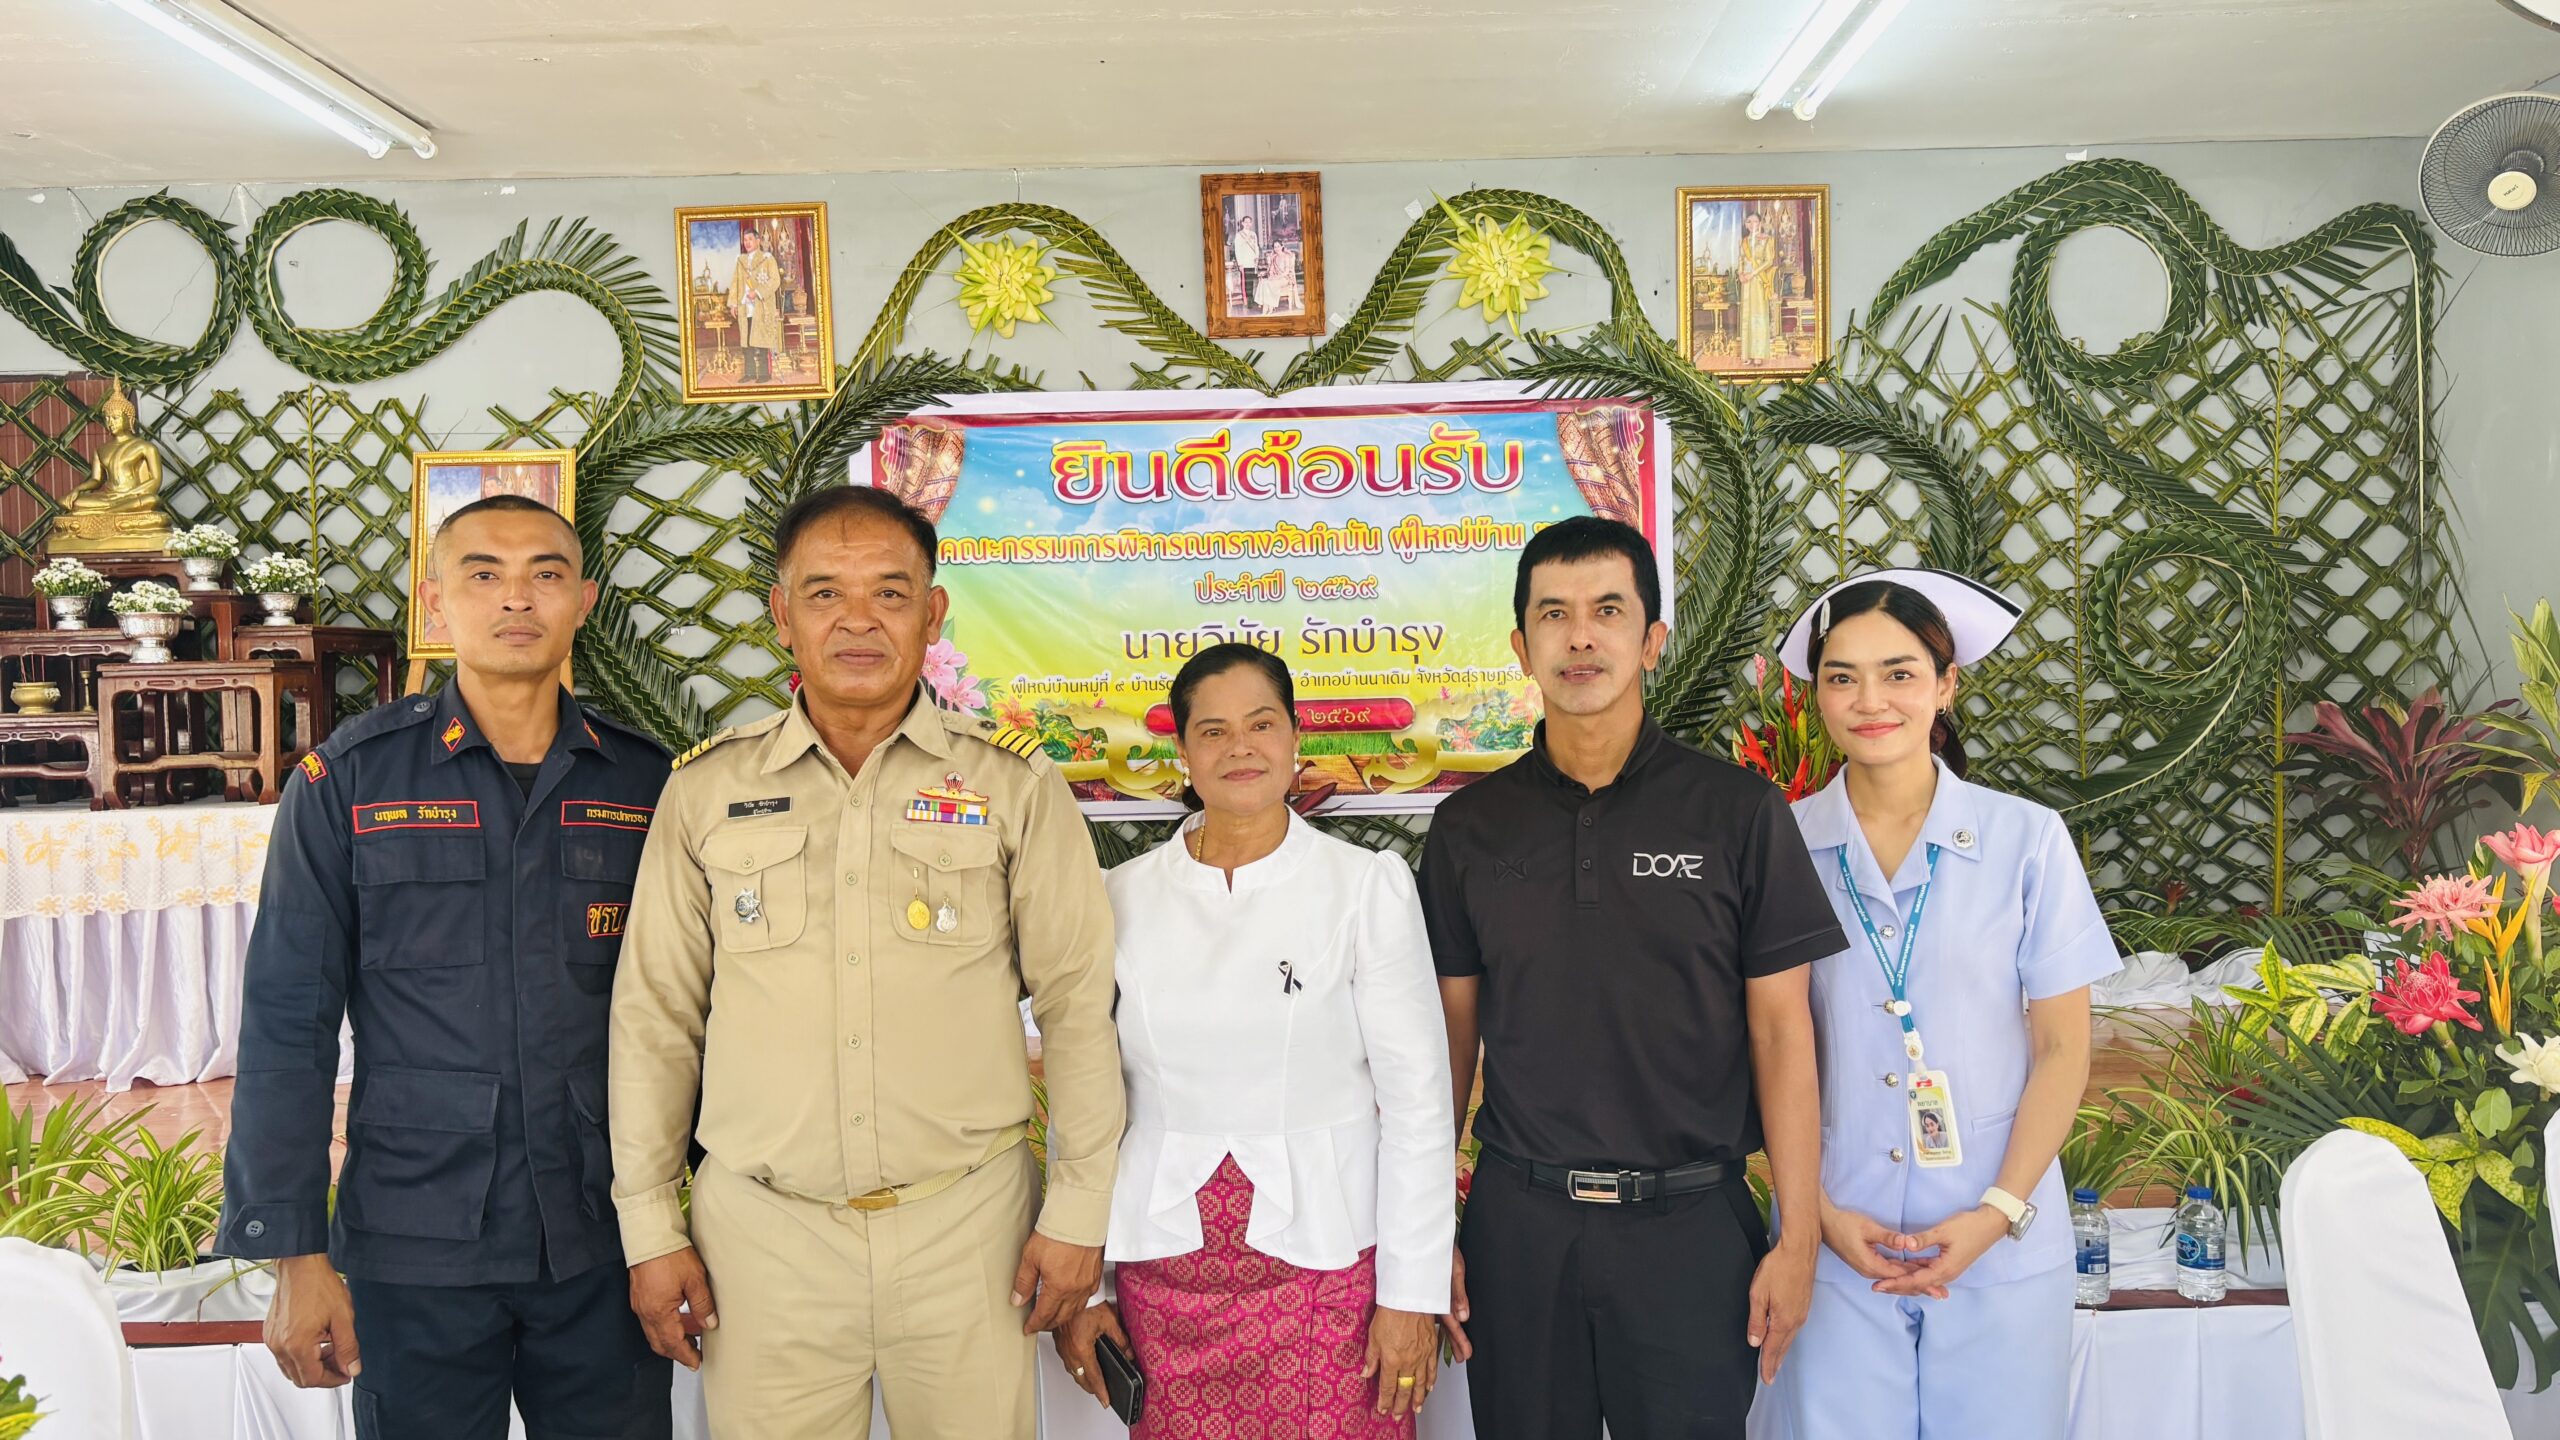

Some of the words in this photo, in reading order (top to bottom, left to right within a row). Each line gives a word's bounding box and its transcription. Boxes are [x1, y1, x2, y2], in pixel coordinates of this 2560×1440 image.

[1049, 421, 1525, 504] ยินดีต้อนรับ
[937, 518, 1382, 565] คณะกรรมการพิจารณารางวัลกำนัน
[1389, 514, 1526, 564] ผู้ใหญ่บ้าน
[1195, 568, 1286, 603] ประจำปี
[1292, 575, 1379, 600] ๒๕๖๙
[1300, 617, 1444, 664] รักบำรุง
[1011, 673, 1109, 698] ผู้ใหญ่บ้านหมู่ที่
[1307, 707, 1371, 724] ๒๕๖๙
